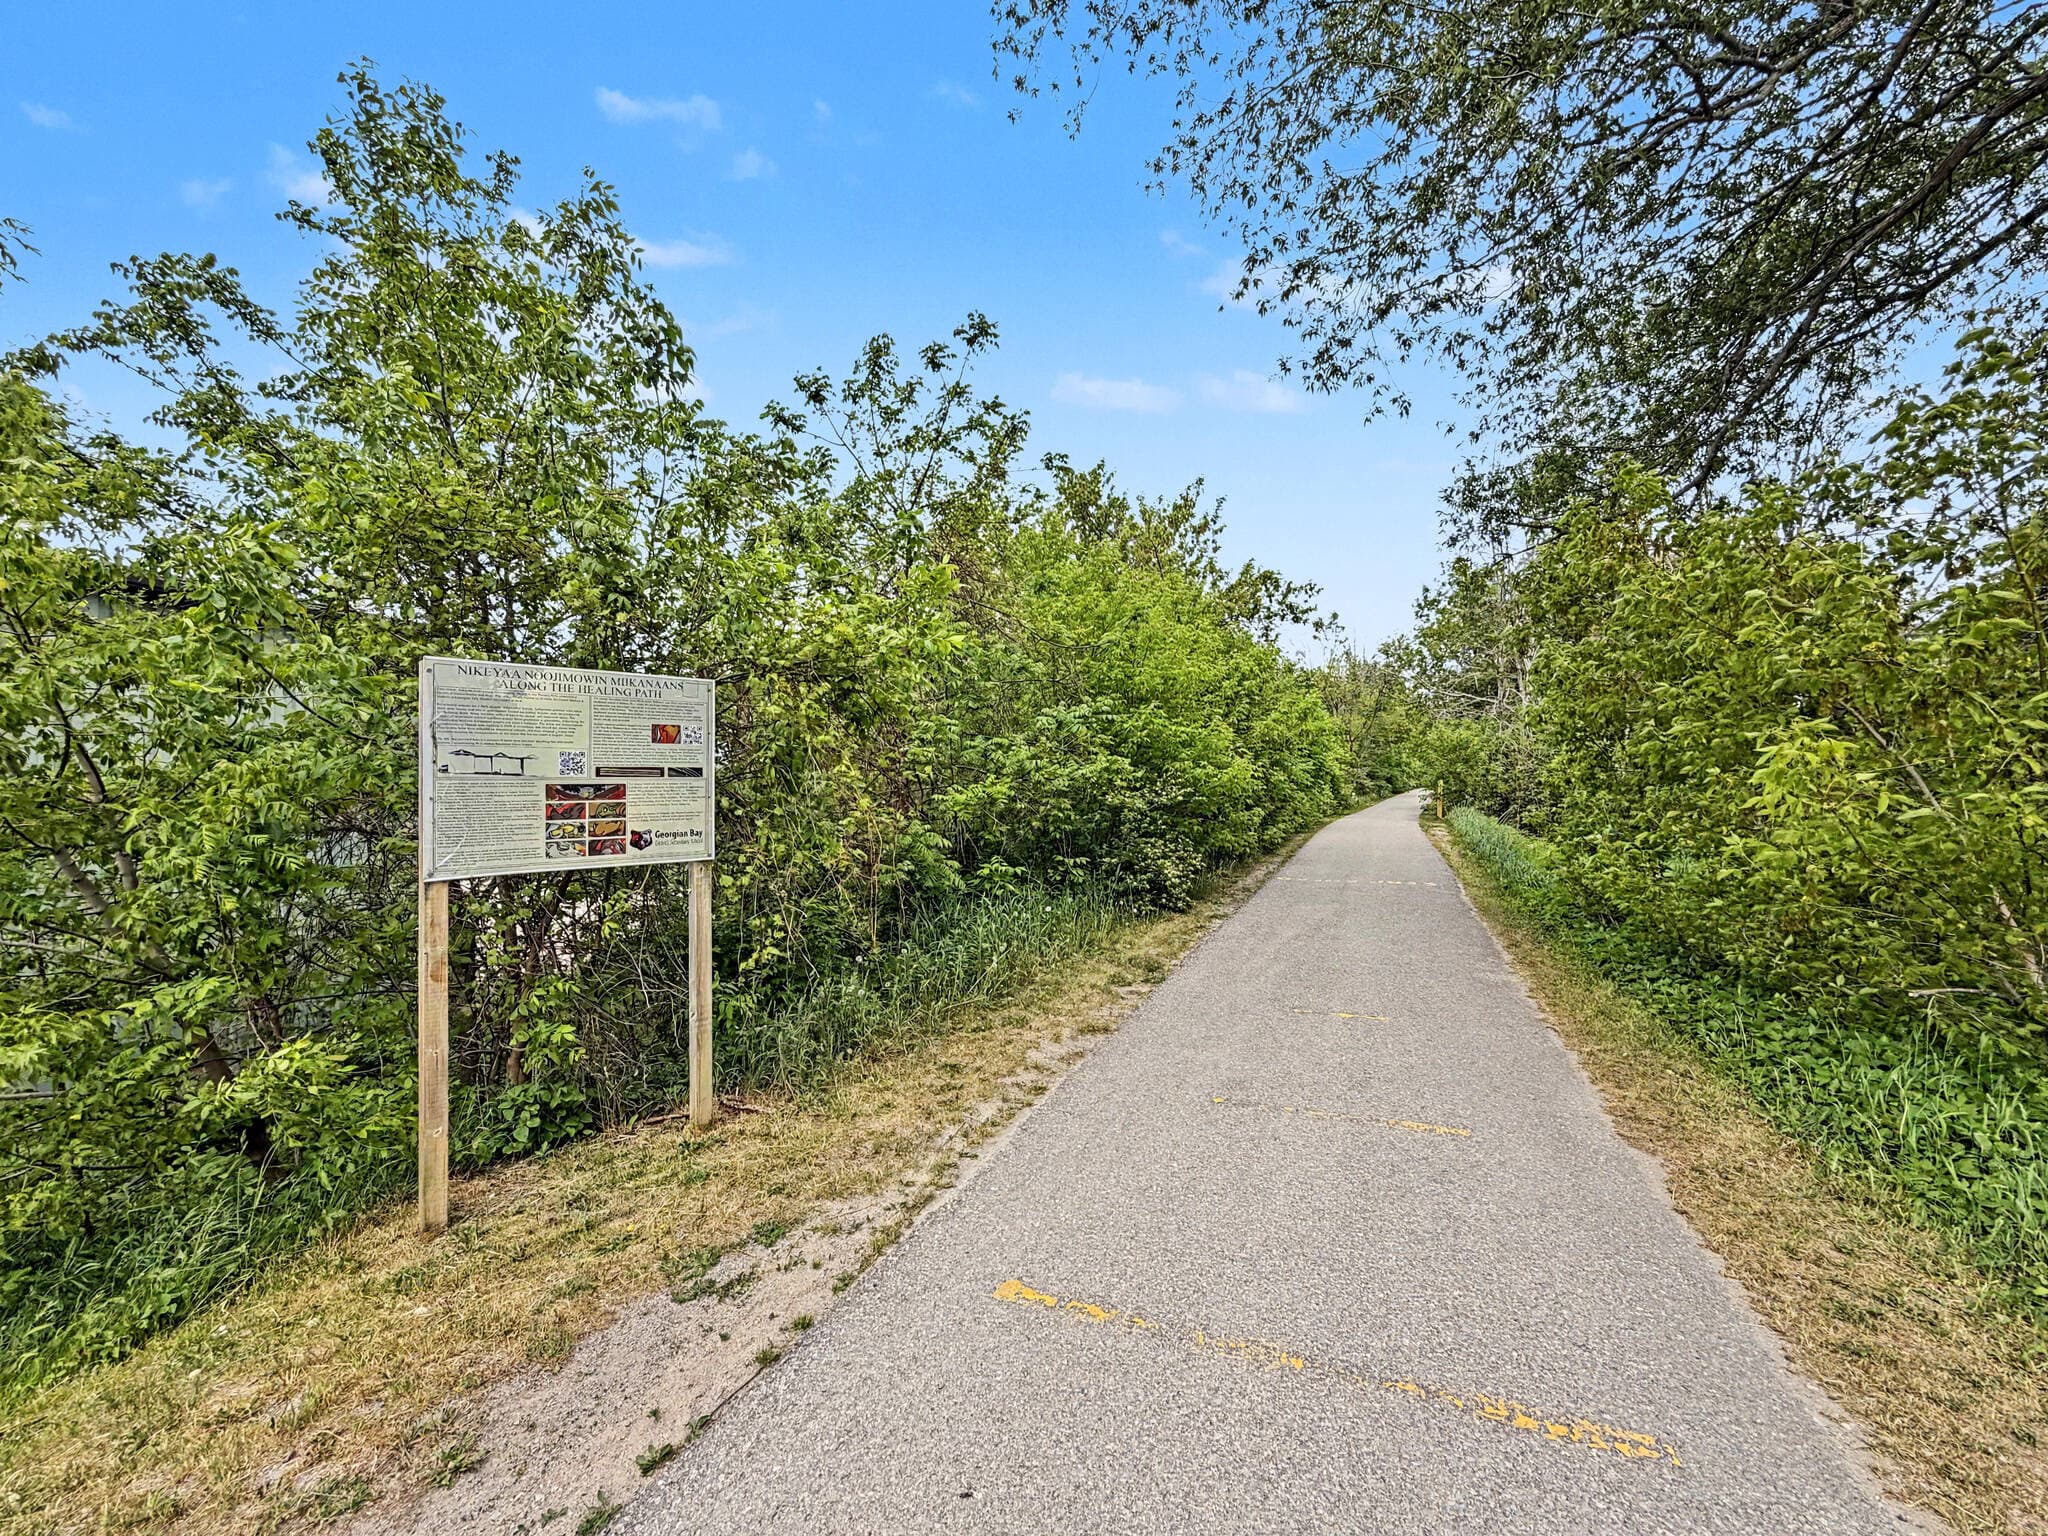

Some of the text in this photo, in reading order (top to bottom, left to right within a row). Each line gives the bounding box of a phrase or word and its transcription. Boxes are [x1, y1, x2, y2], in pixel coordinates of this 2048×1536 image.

[457, 664, 684, 690] NIKEYAA NOOJIMOWIN MIIKANAANS
[500, 680, 546, 692] ALONG
[550, 682, 575, 693] THE
[579, 685, 631, 697] HEALING
[635, 688, 662, 698] PATH
[655, 829, 703, 839] Georgian Bay
